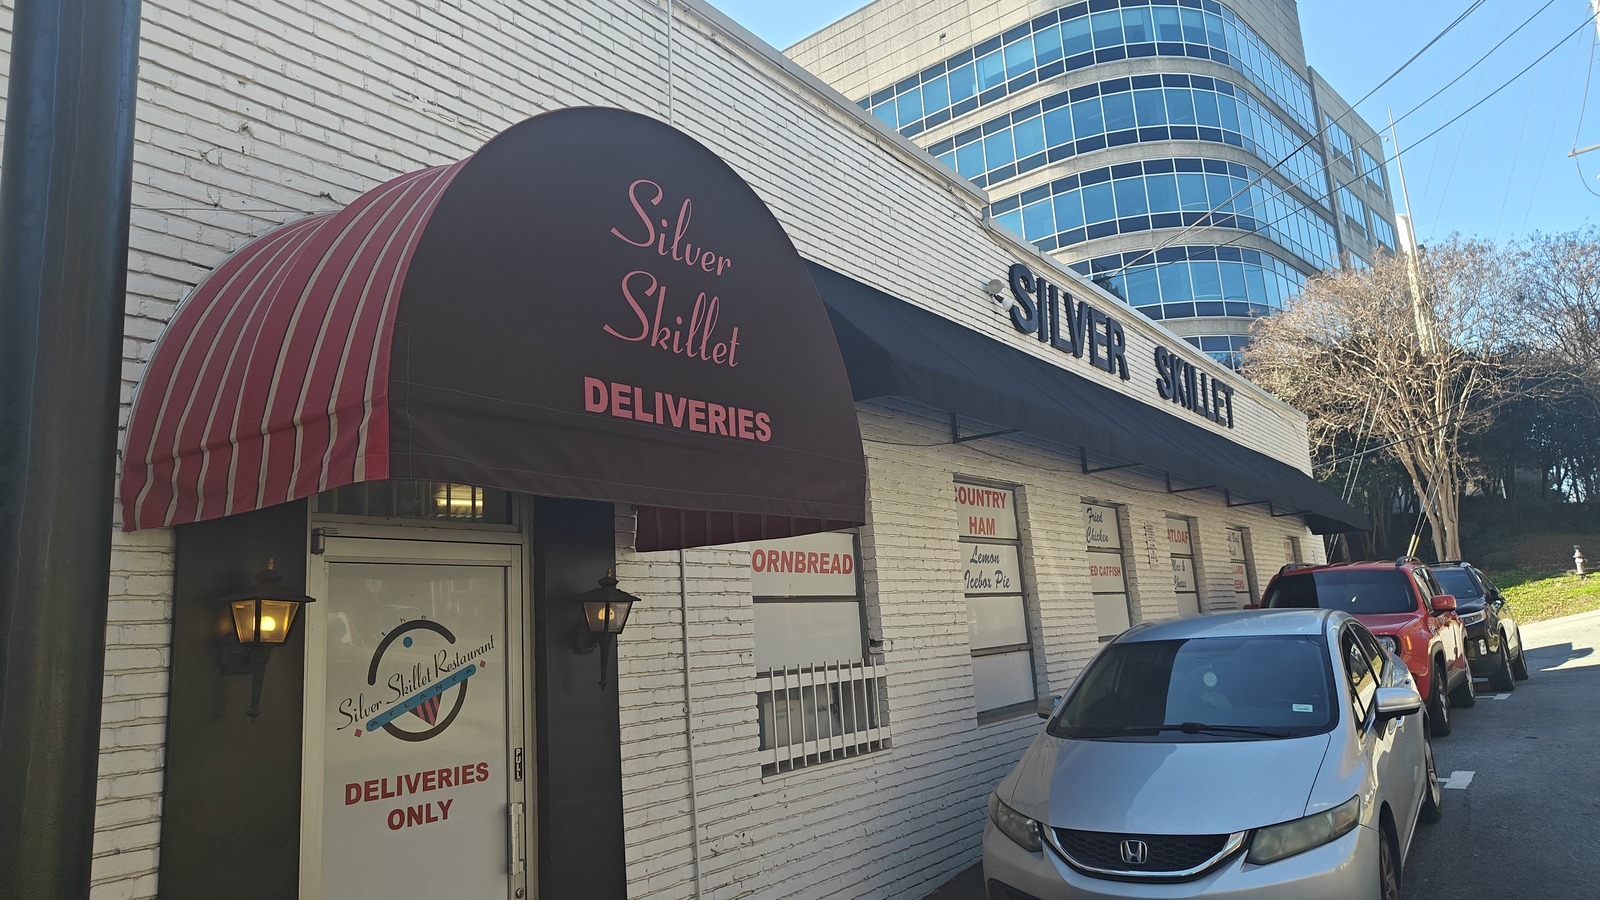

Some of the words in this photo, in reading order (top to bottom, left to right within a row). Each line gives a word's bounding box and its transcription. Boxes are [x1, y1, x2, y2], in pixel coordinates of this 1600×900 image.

[610, 179, 732, 276] Silver
[602, 270, 740, 368] Skillet
[1008, 263, 1131, 382] SILVER
[1154, 345, 1235, 429] SKILLET
[583, 375, 772, 443] DELIVERIES
[969, 515, 996, 536] HAM
[1086, 507, 1103, 524] Fried
[1086, 526, 1109, 543] Chicken
[751, 548, 854, 575] ORNBREAD
[970, 545, 1000, 565] Lemon
[1089, 565, 1099, 577] ED
[1099, 565, 1121, 577] CATFISH
[964, 569, 992, 589] Icebox
[995, 569, 1010, 589] Pie
[336, 692, 382, 731] Silver
[386, 662, 431, 705] Skillet
[433, 634, 495, 678] Restaurant
[370, 668, 473, 728] ATLANTA
[344, 761, 490, 806] DELIVERIES
[387, 798, 454, 831] ONLY
